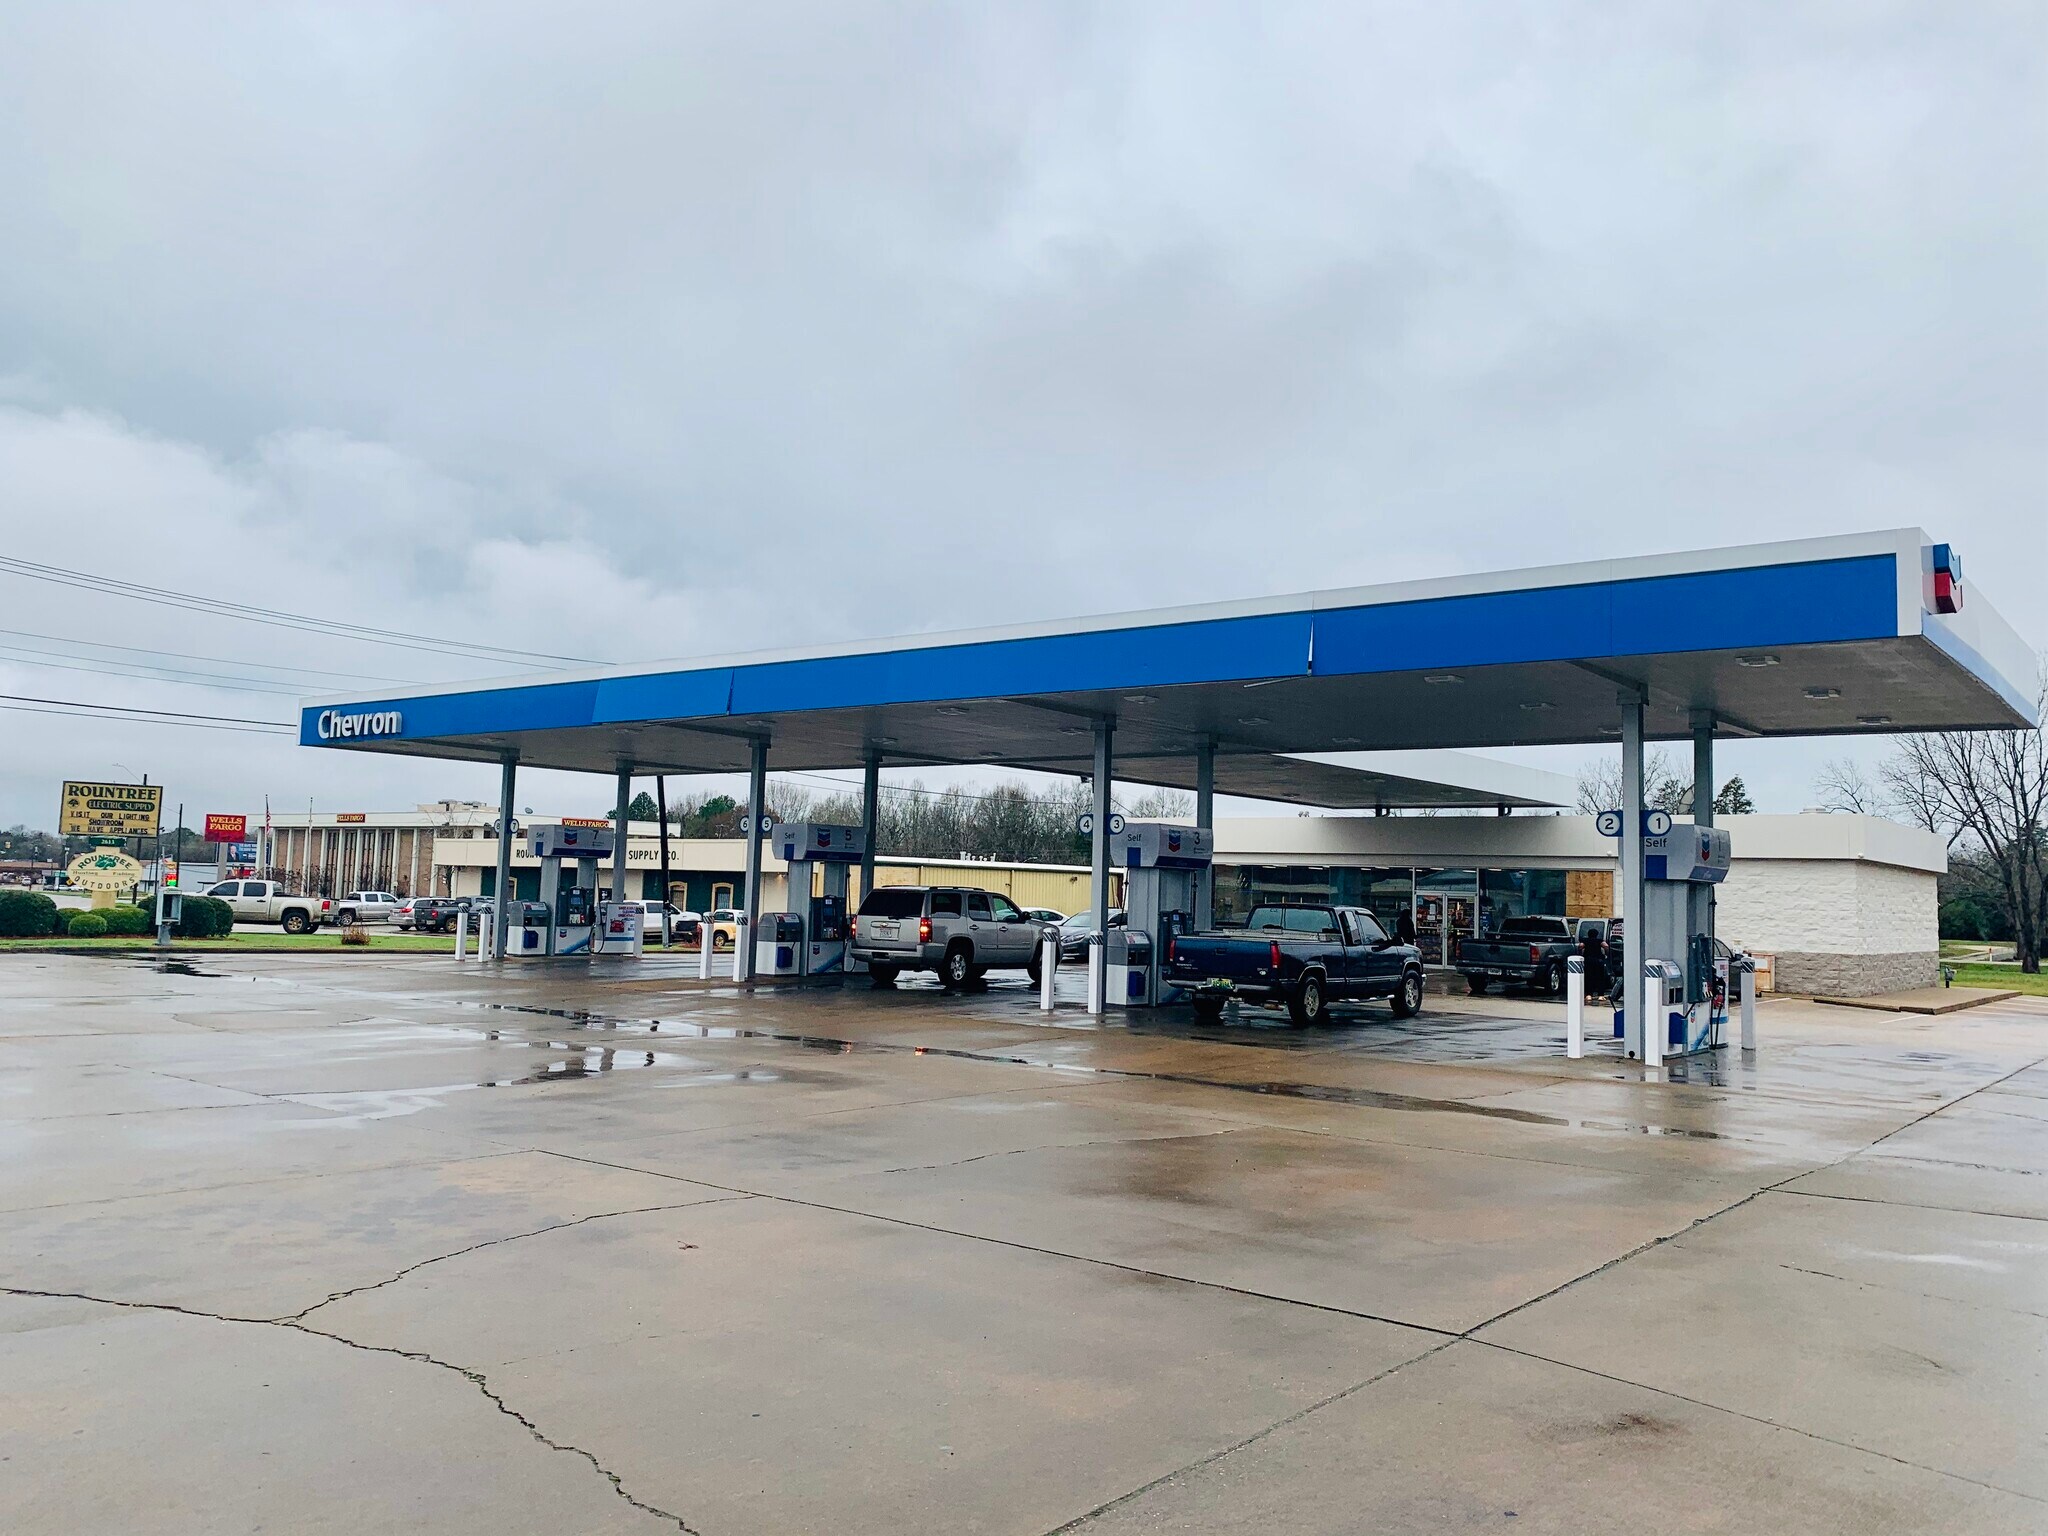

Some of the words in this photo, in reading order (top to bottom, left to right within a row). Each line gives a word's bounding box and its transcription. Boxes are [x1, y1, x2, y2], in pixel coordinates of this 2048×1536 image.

[318, 709, 402, 739] Chevron
[68, 785, 156, 800] ROUNTREE
[88, 800, 123, 809] ELECTRIC
[125, 802, 152, 811] SUPPLY
[119, 813, 149, 821] LIGHTING
[209, 816, 243, 825] WELLS
[209, 823, 242, 831] FARGO
[512, 822, 517, 830] 7
[564, 819, 587, 827] WELLS
[743, 819, 748, 827] 6
[764, 819, 769, 828] 5
[1083, 819, 1090, 829] 4
[1114, 819, 1120, 829] 3
[1605, 818, 1614, 830] 2
[1656, 817, 1661, 830] 1
[592, 830, 599, 840] 7
[845, 830, 852, 841] 5
[1127, 833, 1142, 842] Self
[1194, 831, 1201, 845] 3
[1645, 838, 1667, 848] Self
[628, 850, 659, 860] SUPPLY
[74, 875, 134, 890] OUTDOORS
